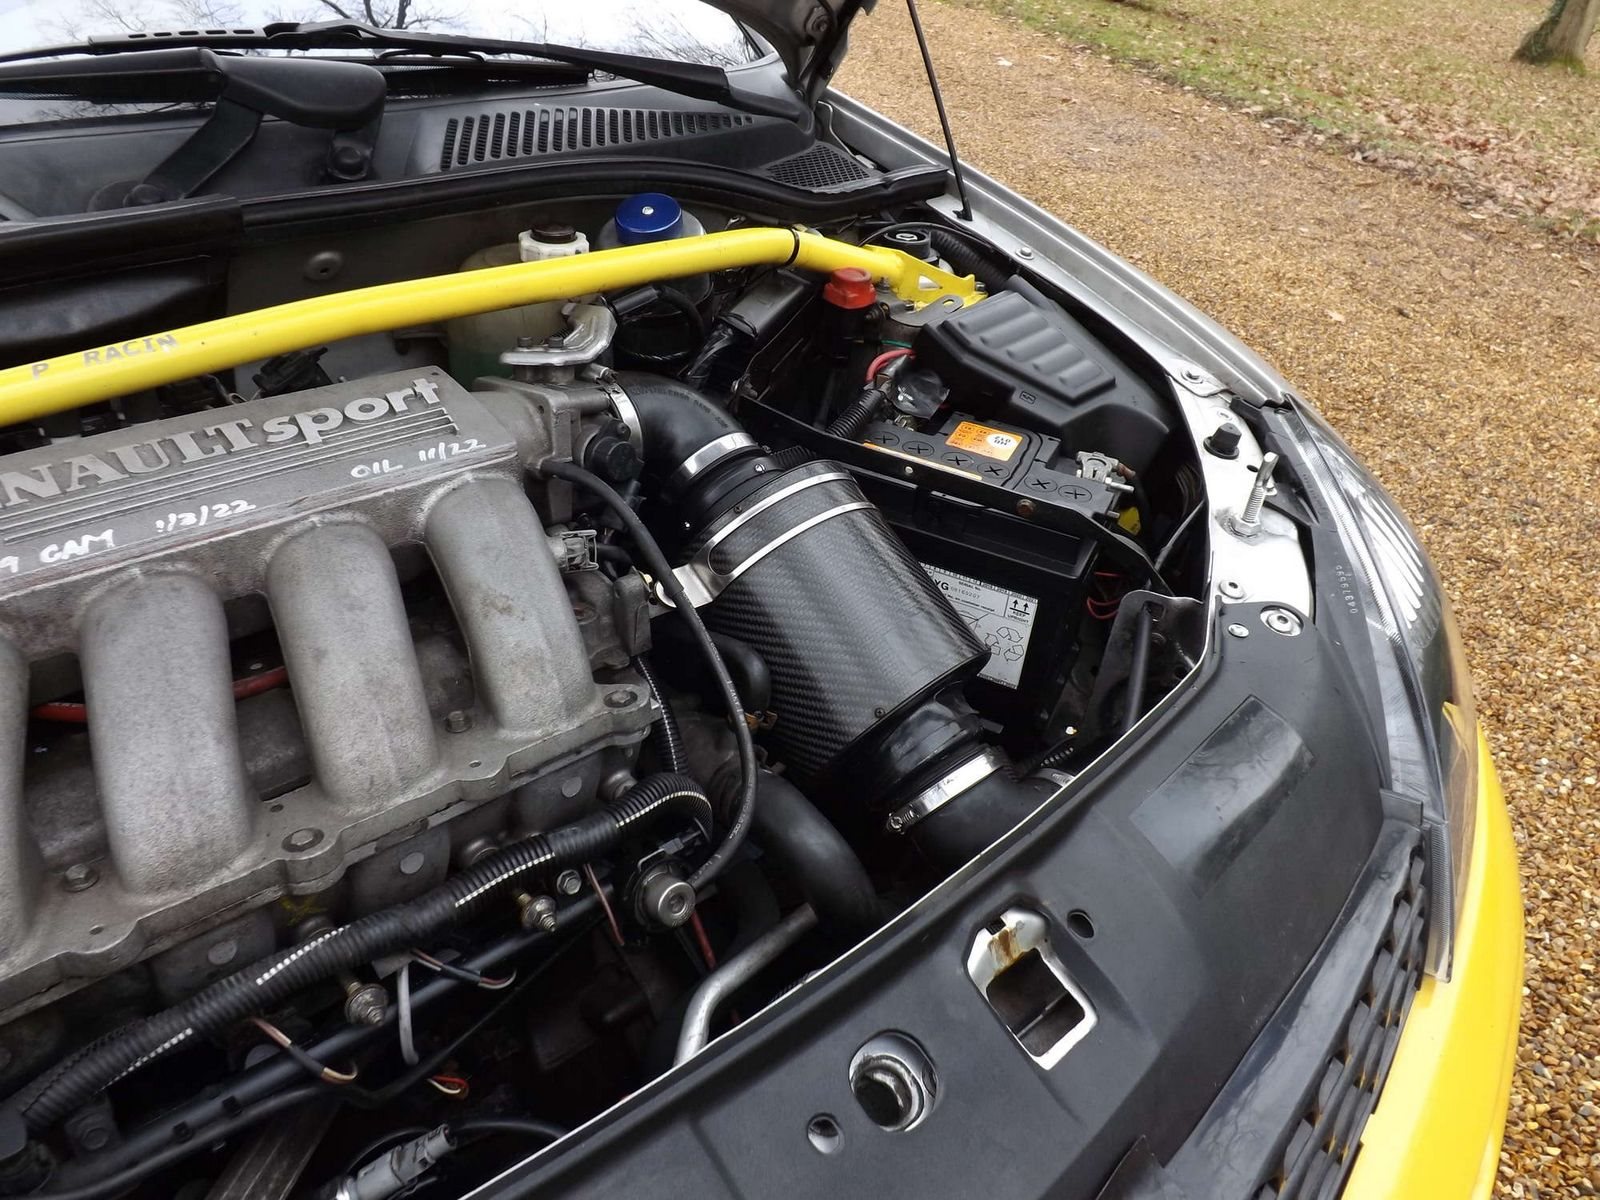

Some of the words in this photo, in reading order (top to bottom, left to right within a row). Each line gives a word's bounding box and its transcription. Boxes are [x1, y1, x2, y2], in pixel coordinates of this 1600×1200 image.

[350, 459, 404, 478] OIL
[418, 438, 487, 461] 11/22
[40, 529, 115, 563] CAM
